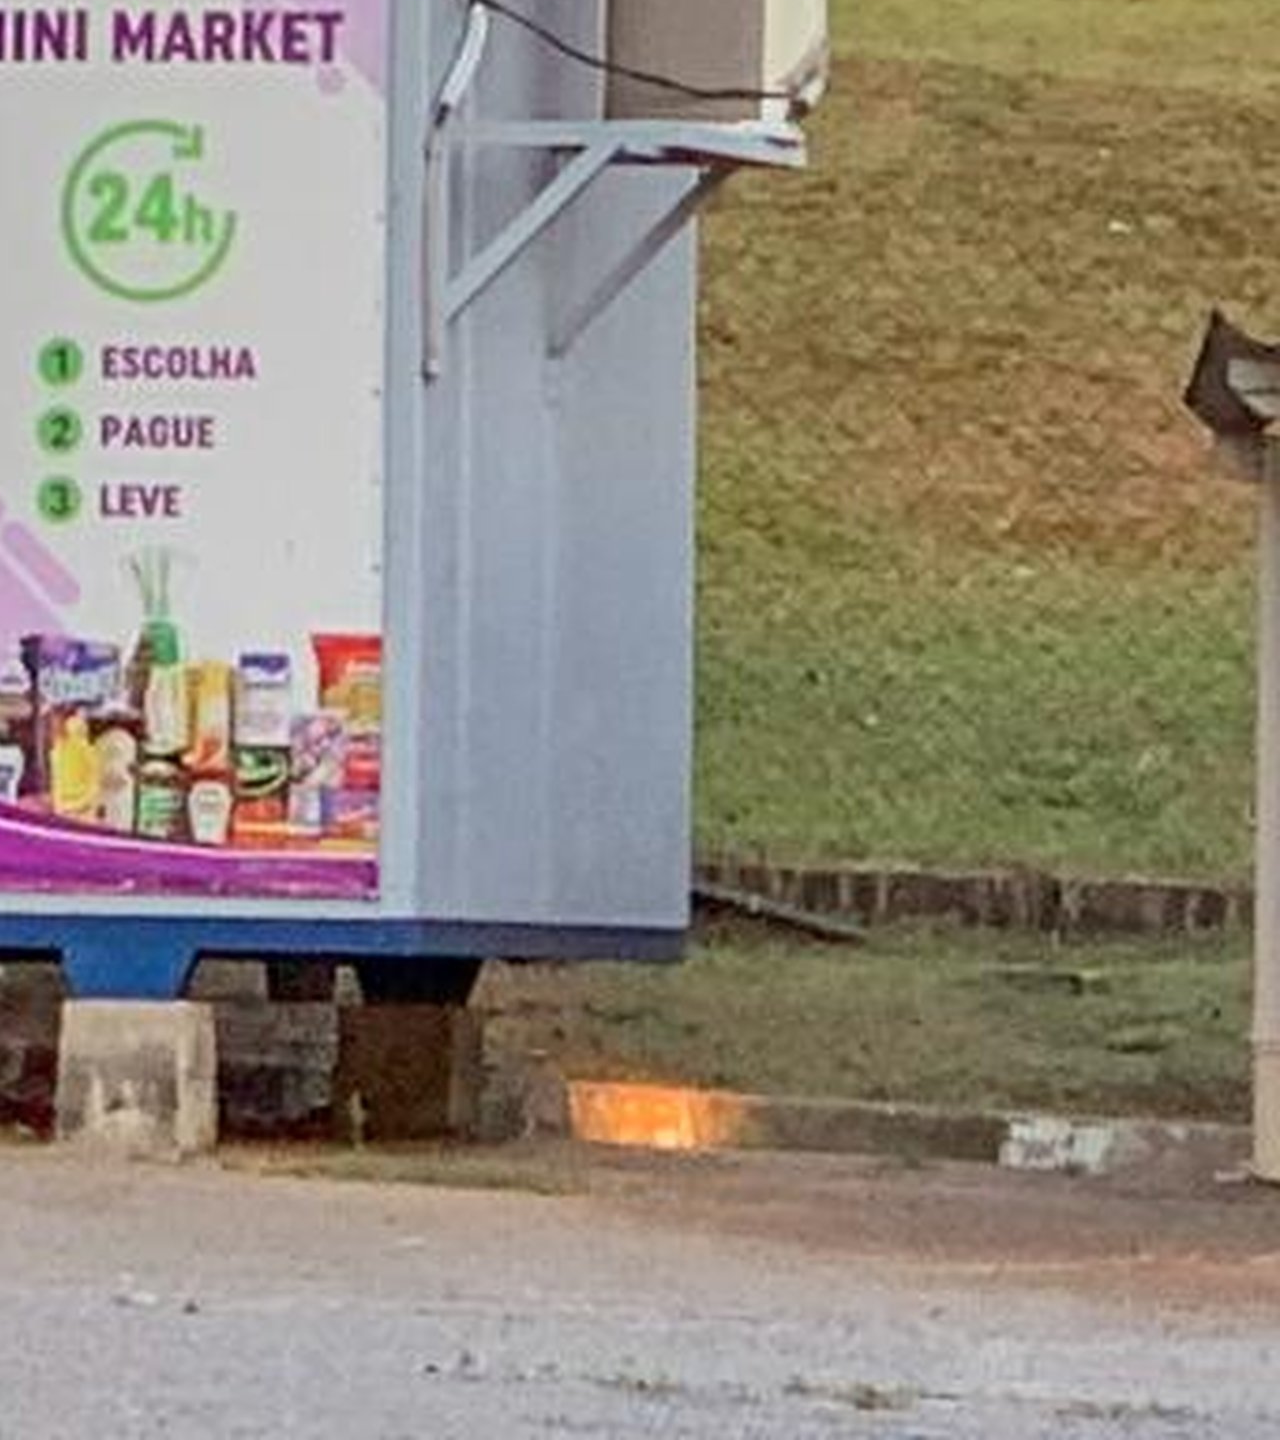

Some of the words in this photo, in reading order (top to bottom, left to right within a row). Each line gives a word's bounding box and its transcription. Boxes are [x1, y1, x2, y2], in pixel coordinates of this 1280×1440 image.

[112, 9, 344, 62] MARKET
[88, 172, 215, 243] 24h
[101, 345, 256, 380] ESCOLHA
[100, 414, 215, 449] PAGUE
[100, 482, 182, 518] LEVE
